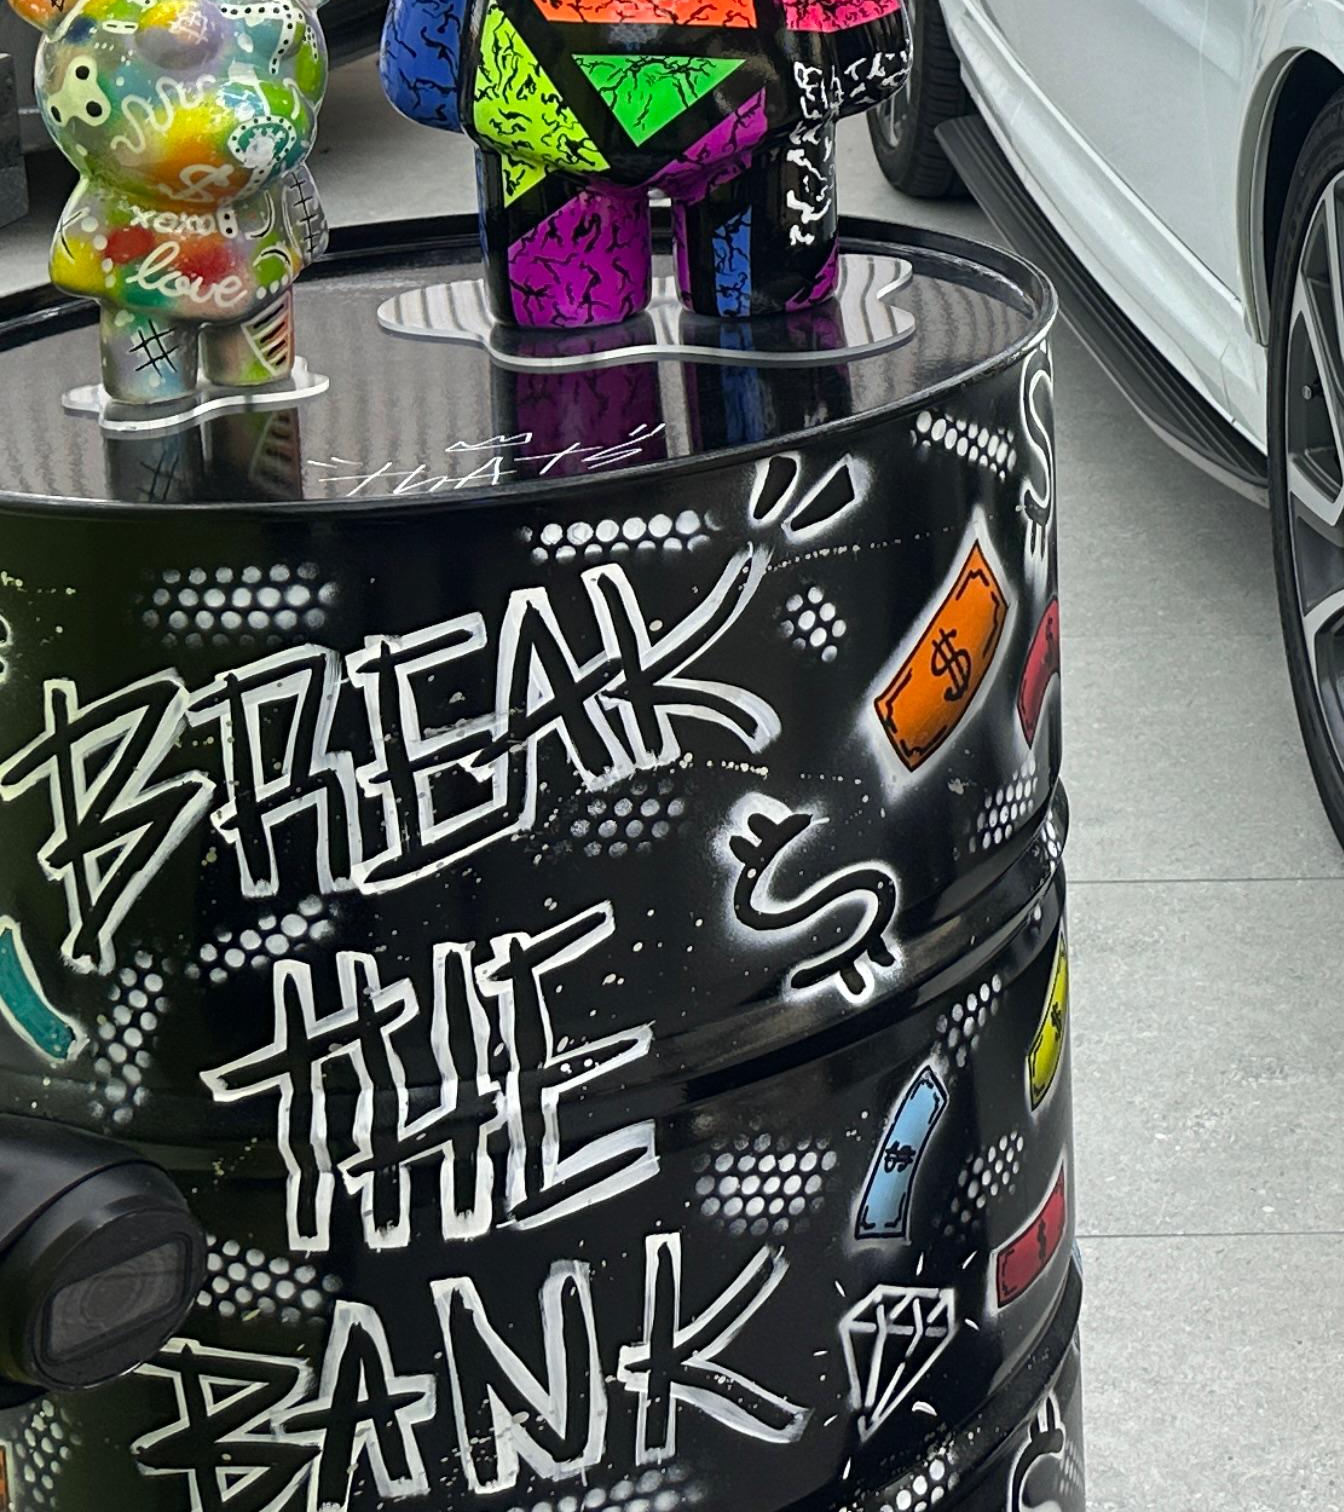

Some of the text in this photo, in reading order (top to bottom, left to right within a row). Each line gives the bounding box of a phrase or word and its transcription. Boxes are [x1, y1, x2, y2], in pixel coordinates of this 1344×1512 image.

[125, 240, 248, 308] love
[0, 543, 784, 975] BREAK
[199, 900, 662, 1251] THE
[130, 1231, 812, 1512] BANK
